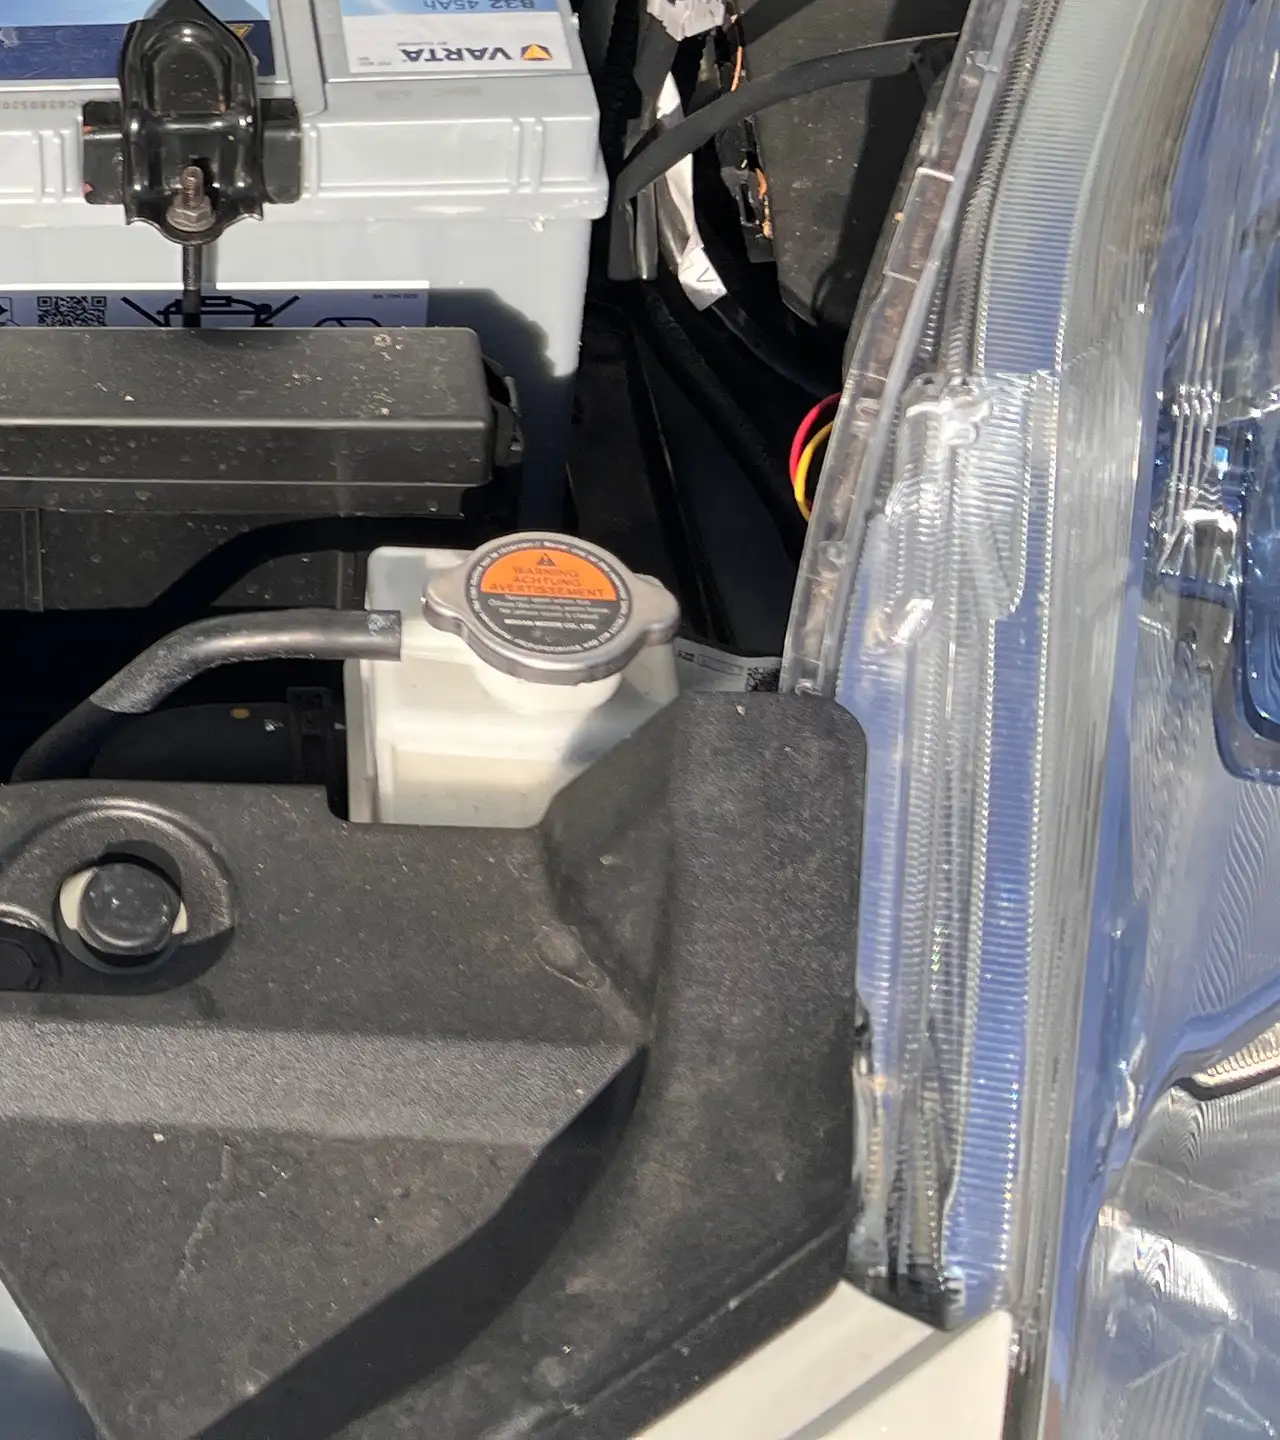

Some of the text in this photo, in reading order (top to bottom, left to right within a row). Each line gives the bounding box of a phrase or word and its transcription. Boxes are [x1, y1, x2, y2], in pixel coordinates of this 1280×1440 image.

[398, 46, 514, 62] VARTA
[512, 565, 580, 578] WARNING
[513, 575, 581, 588] ACHTUNG
[490, 583, 605, 598] AVERTISSEMENT
